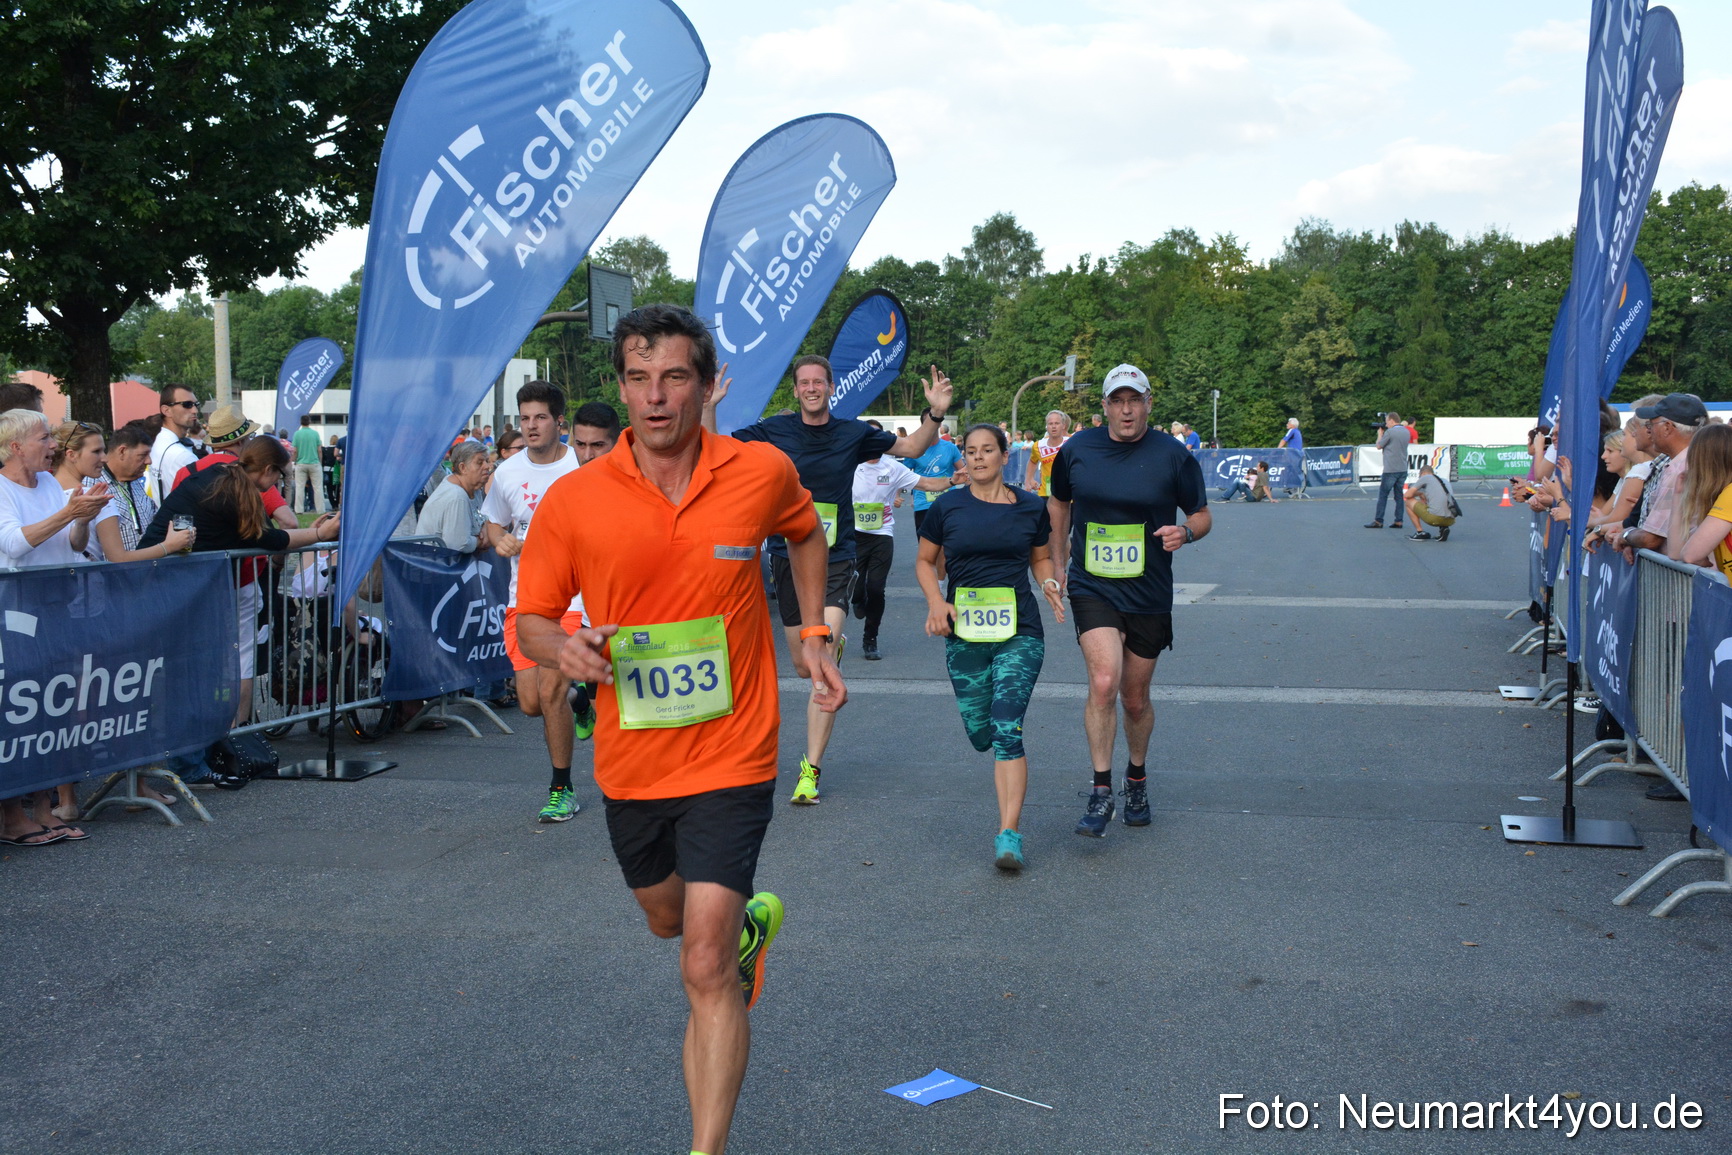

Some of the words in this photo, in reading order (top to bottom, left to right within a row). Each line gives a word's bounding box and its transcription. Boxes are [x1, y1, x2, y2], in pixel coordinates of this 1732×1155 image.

[449, 29, 634, 271] Fischer
[513, 77, 654, 269] AUTOMOBILE
[739, 151, 848, 325] Fischer
[777, 182, 862, 322] AUTOMOBILE
[1608, 331, 1622, 354] und
[1619, 299, 1644, 335] Medien
[884, 340, 905, 366] Medien
[292, 349, 330, 401] Fischer
[304, 359, 335, 401] AUTOMOBILE
[828, 348, 882, 410] ischmann
[1229, 464, 1285, 476] Fiser
[1462, 451, 1487, 466] AOK
[823, 522, 832, 535] 7
[858, 513, 877, 523] 999
[1091, 545, 1138, 562] 1310
[457, 599, 506, 639] Fisc
[961, 609, 1011, 626] 1305
[0, 653, 164, 725] scher
[627, 659, 719, 699] 1033
[655, 705, 672, 713] Gerd
[673, 703, 695, 712] Fricke
[0, 709, 148, 764] UTOMOBILE
